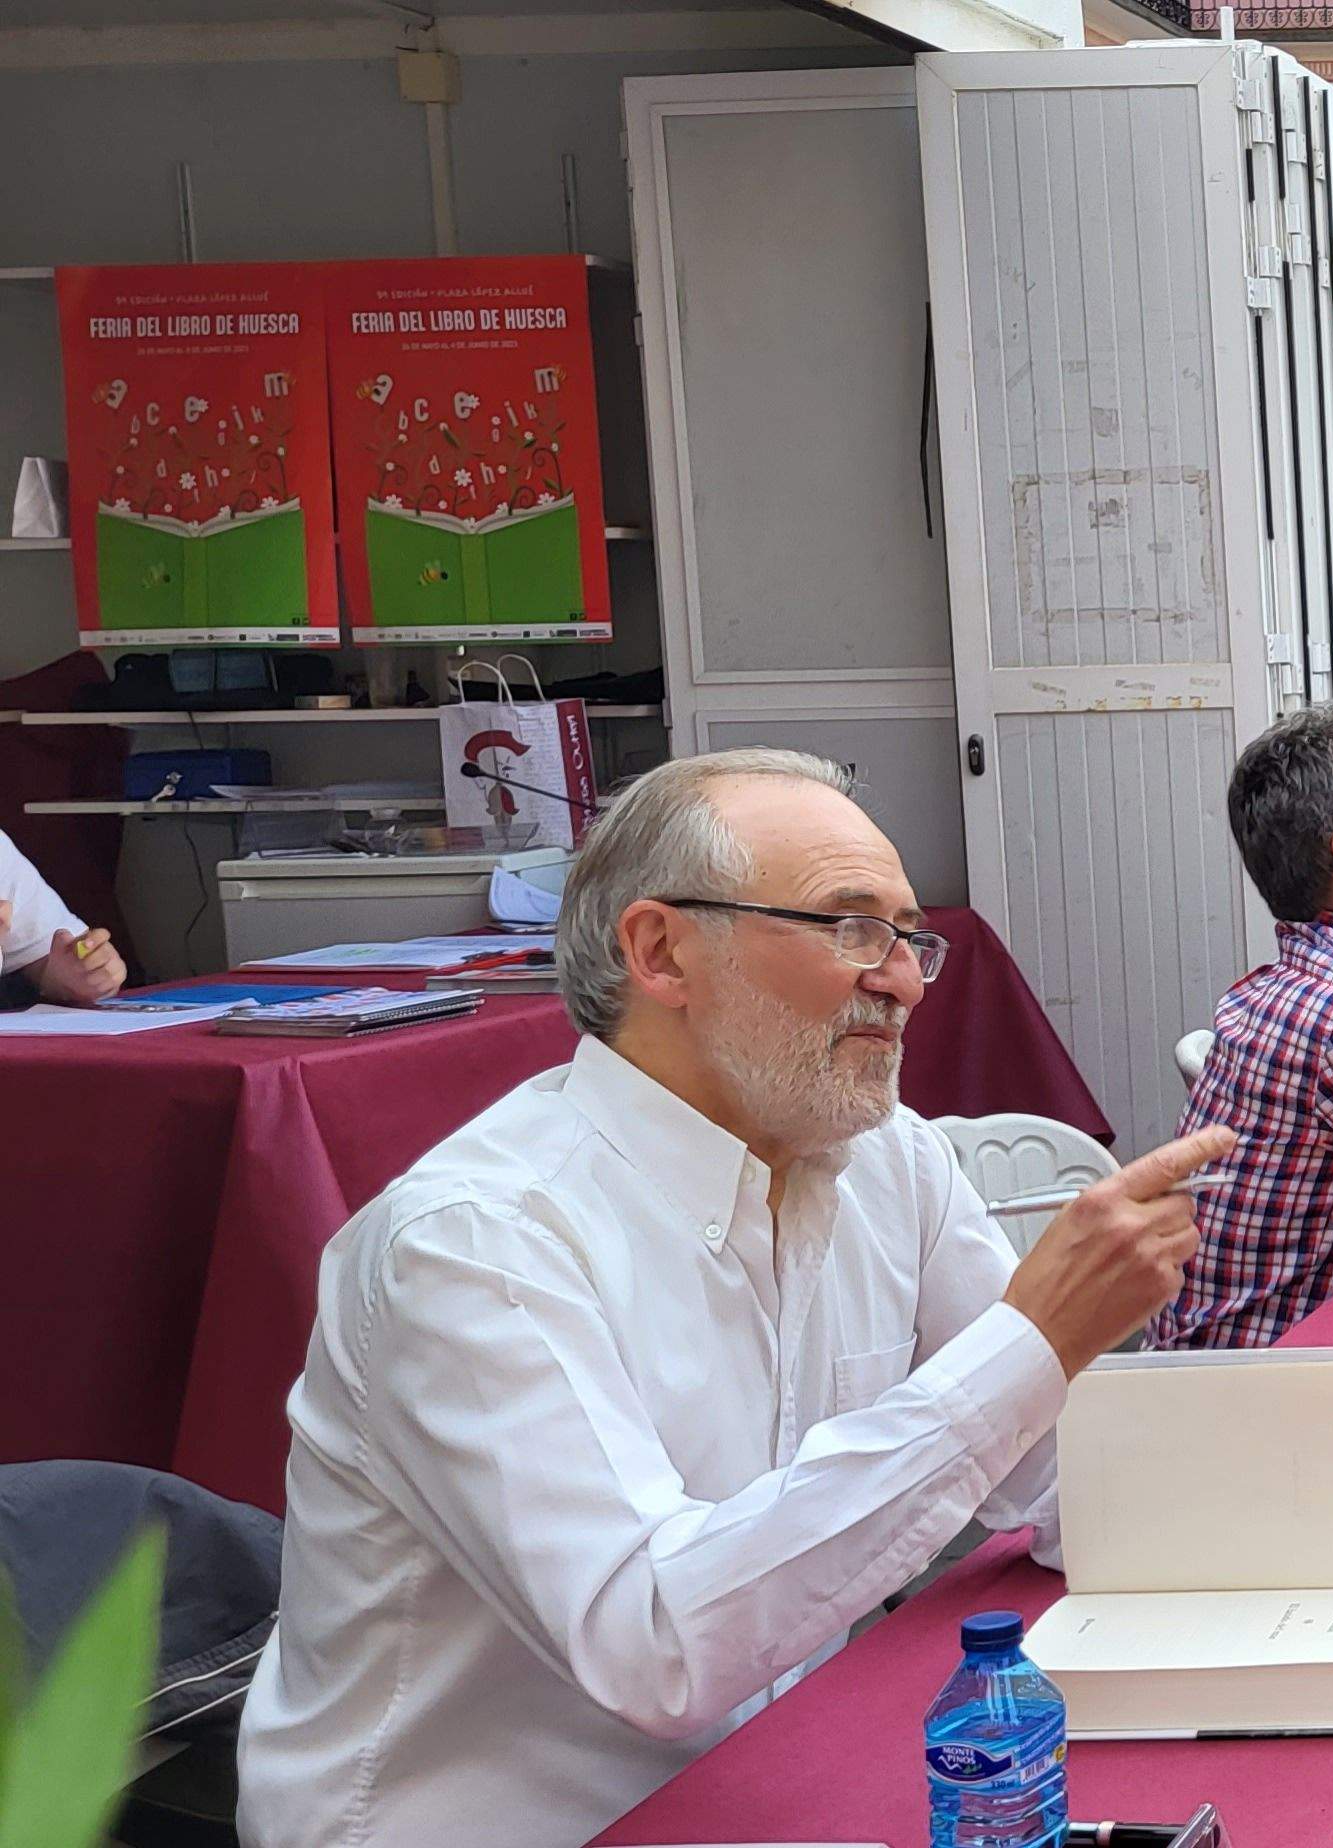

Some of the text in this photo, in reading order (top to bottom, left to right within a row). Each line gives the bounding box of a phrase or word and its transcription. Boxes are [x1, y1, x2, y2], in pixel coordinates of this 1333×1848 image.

[90, 313, 299, 338] FERIA DEL LIBRO DE HUESCA
[352, 307, 566, 333] FERIA DEL LIBRO DE HUESCA
[942, 1746, 975, 1756] MONTE
[947, 1755, 976, 1764] PINOS
